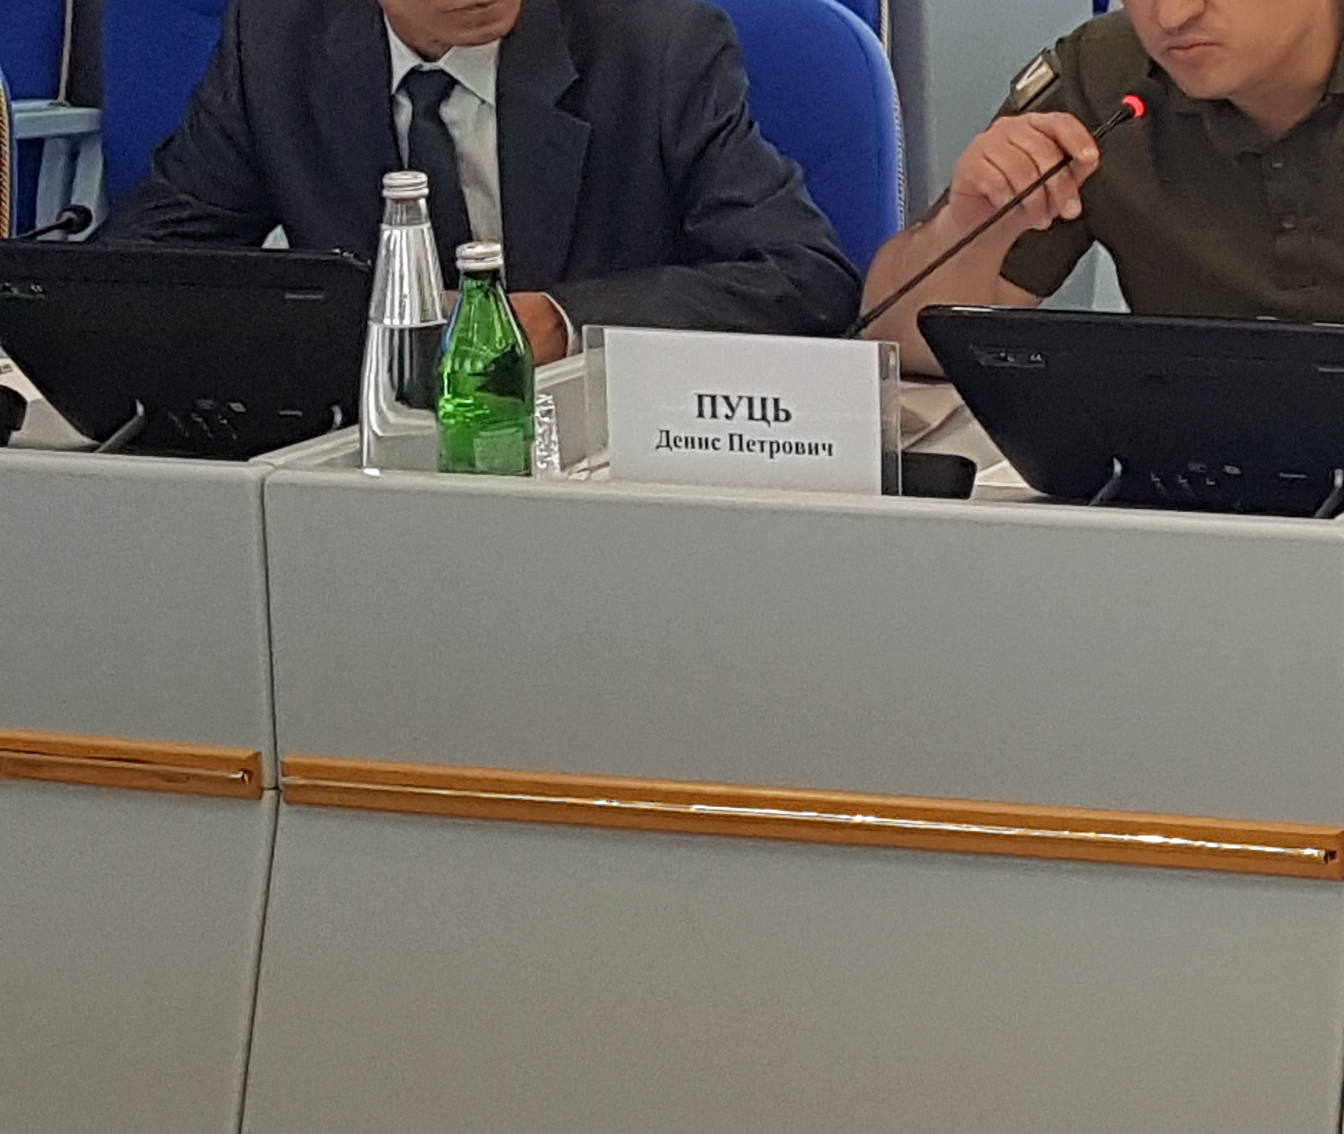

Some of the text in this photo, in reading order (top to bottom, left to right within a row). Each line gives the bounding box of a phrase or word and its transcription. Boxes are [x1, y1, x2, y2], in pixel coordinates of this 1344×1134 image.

[694, 393, 793, 428] ПУЦЬ
[654, 429, 834, 459] Денис Петрович
